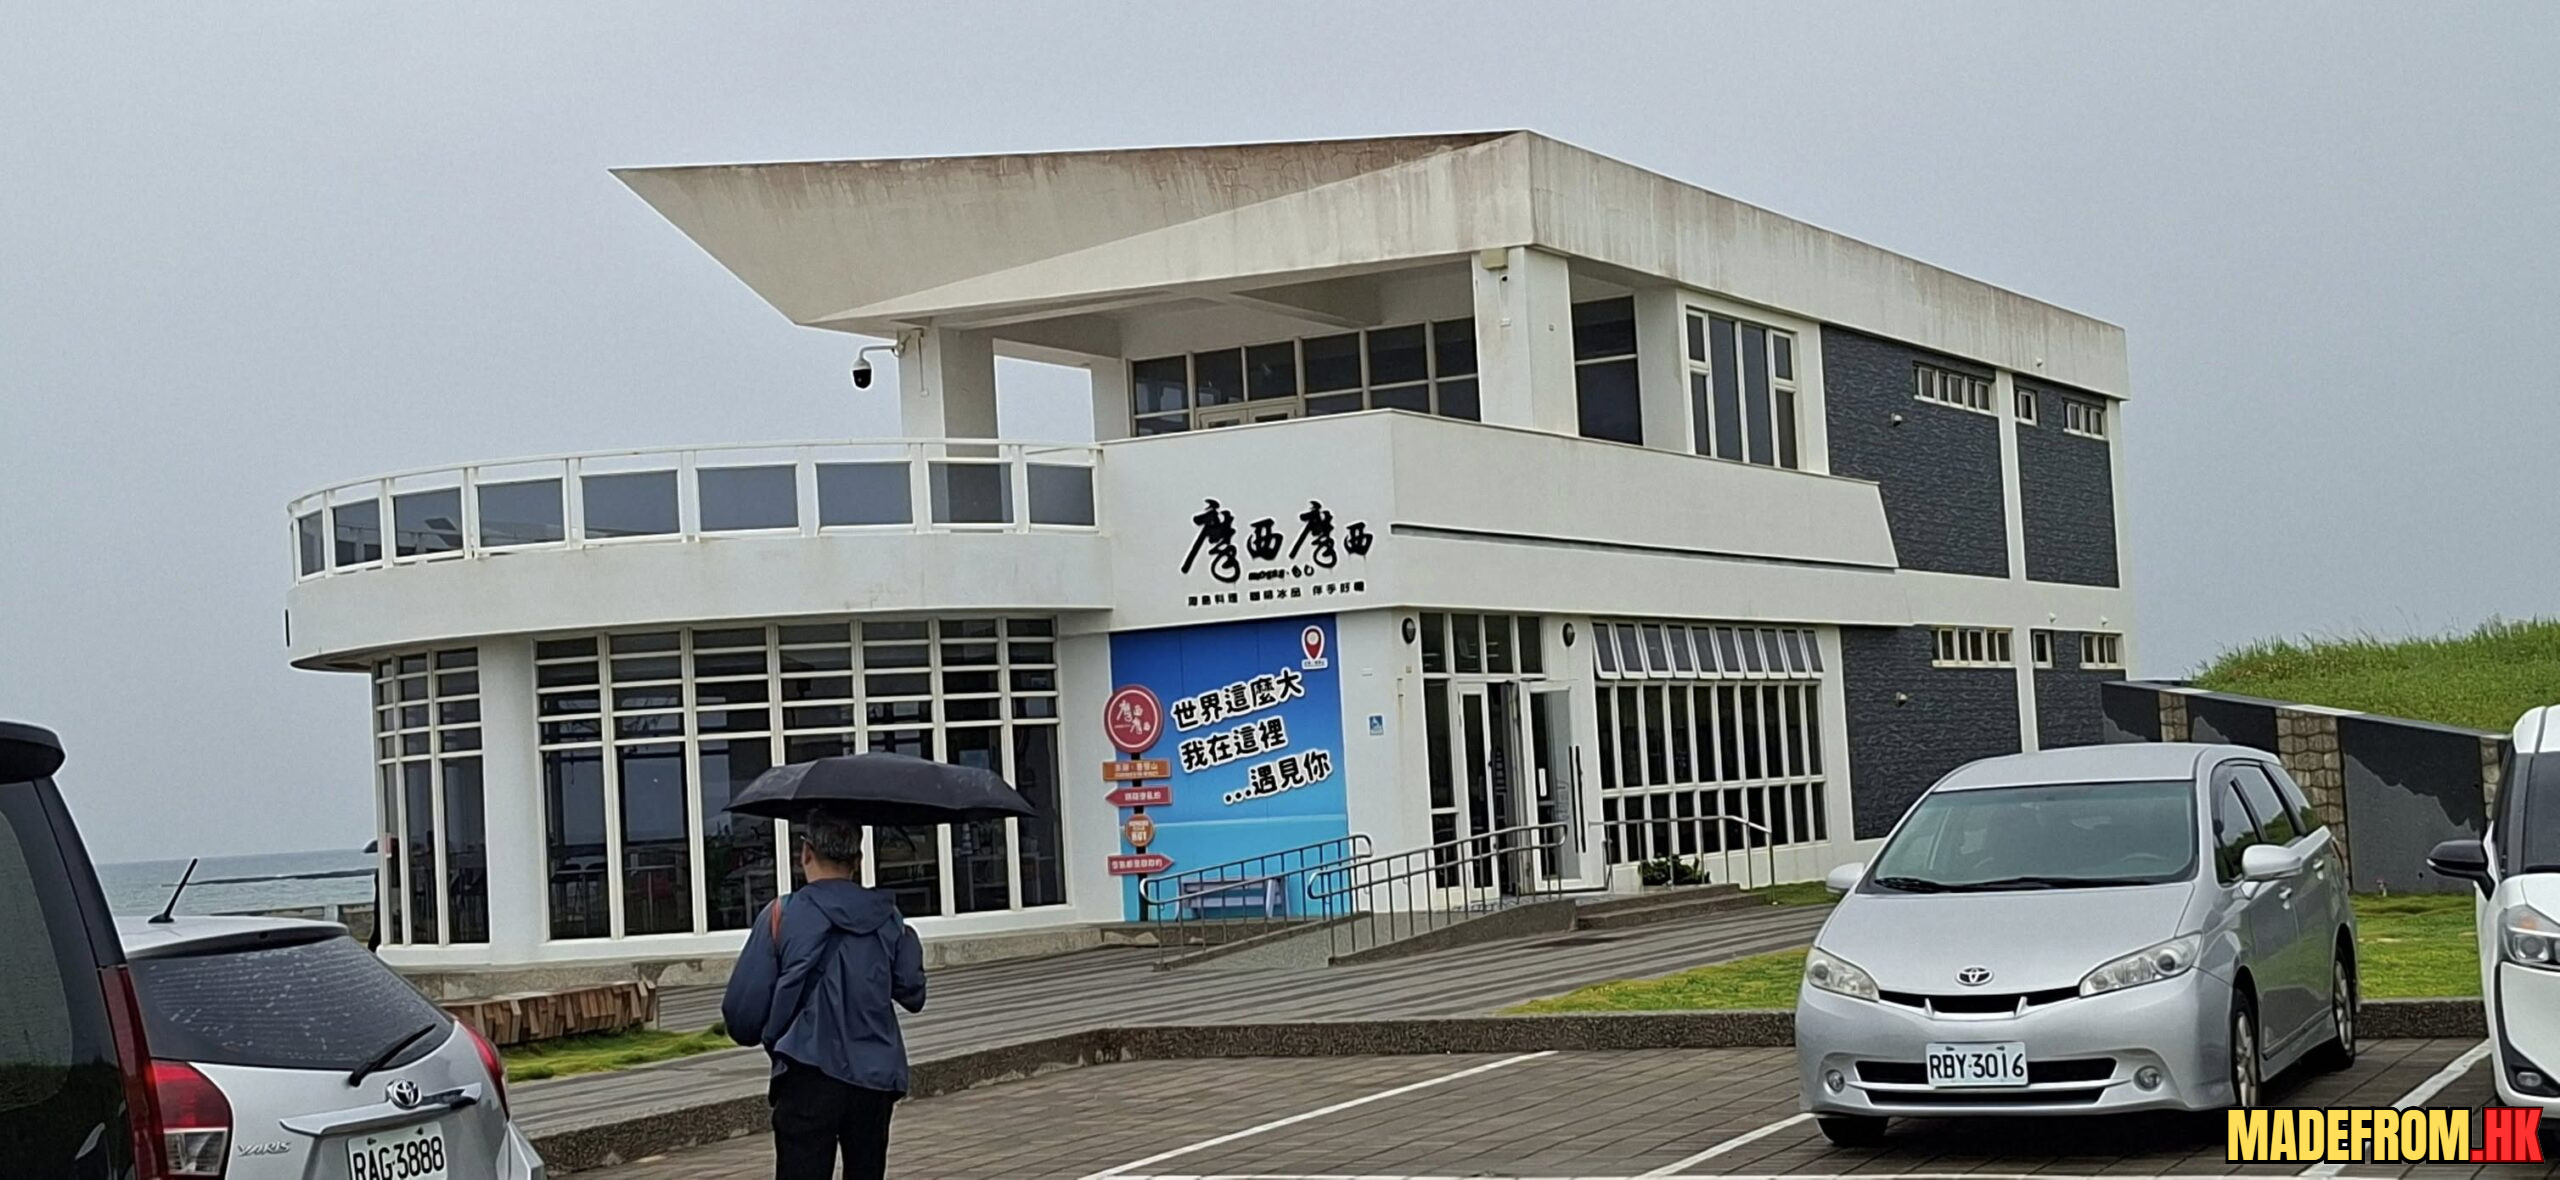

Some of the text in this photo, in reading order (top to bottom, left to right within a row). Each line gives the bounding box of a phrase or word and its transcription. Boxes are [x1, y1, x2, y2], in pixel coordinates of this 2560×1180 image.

[1181, 499, 1374, 583] 摩西摩西
[1173, 669, 1303, 729] 世界這麼大
[1180, 718, 1287, 770] 我在這裡
[237, 1140, 292, 1157] YARIS
